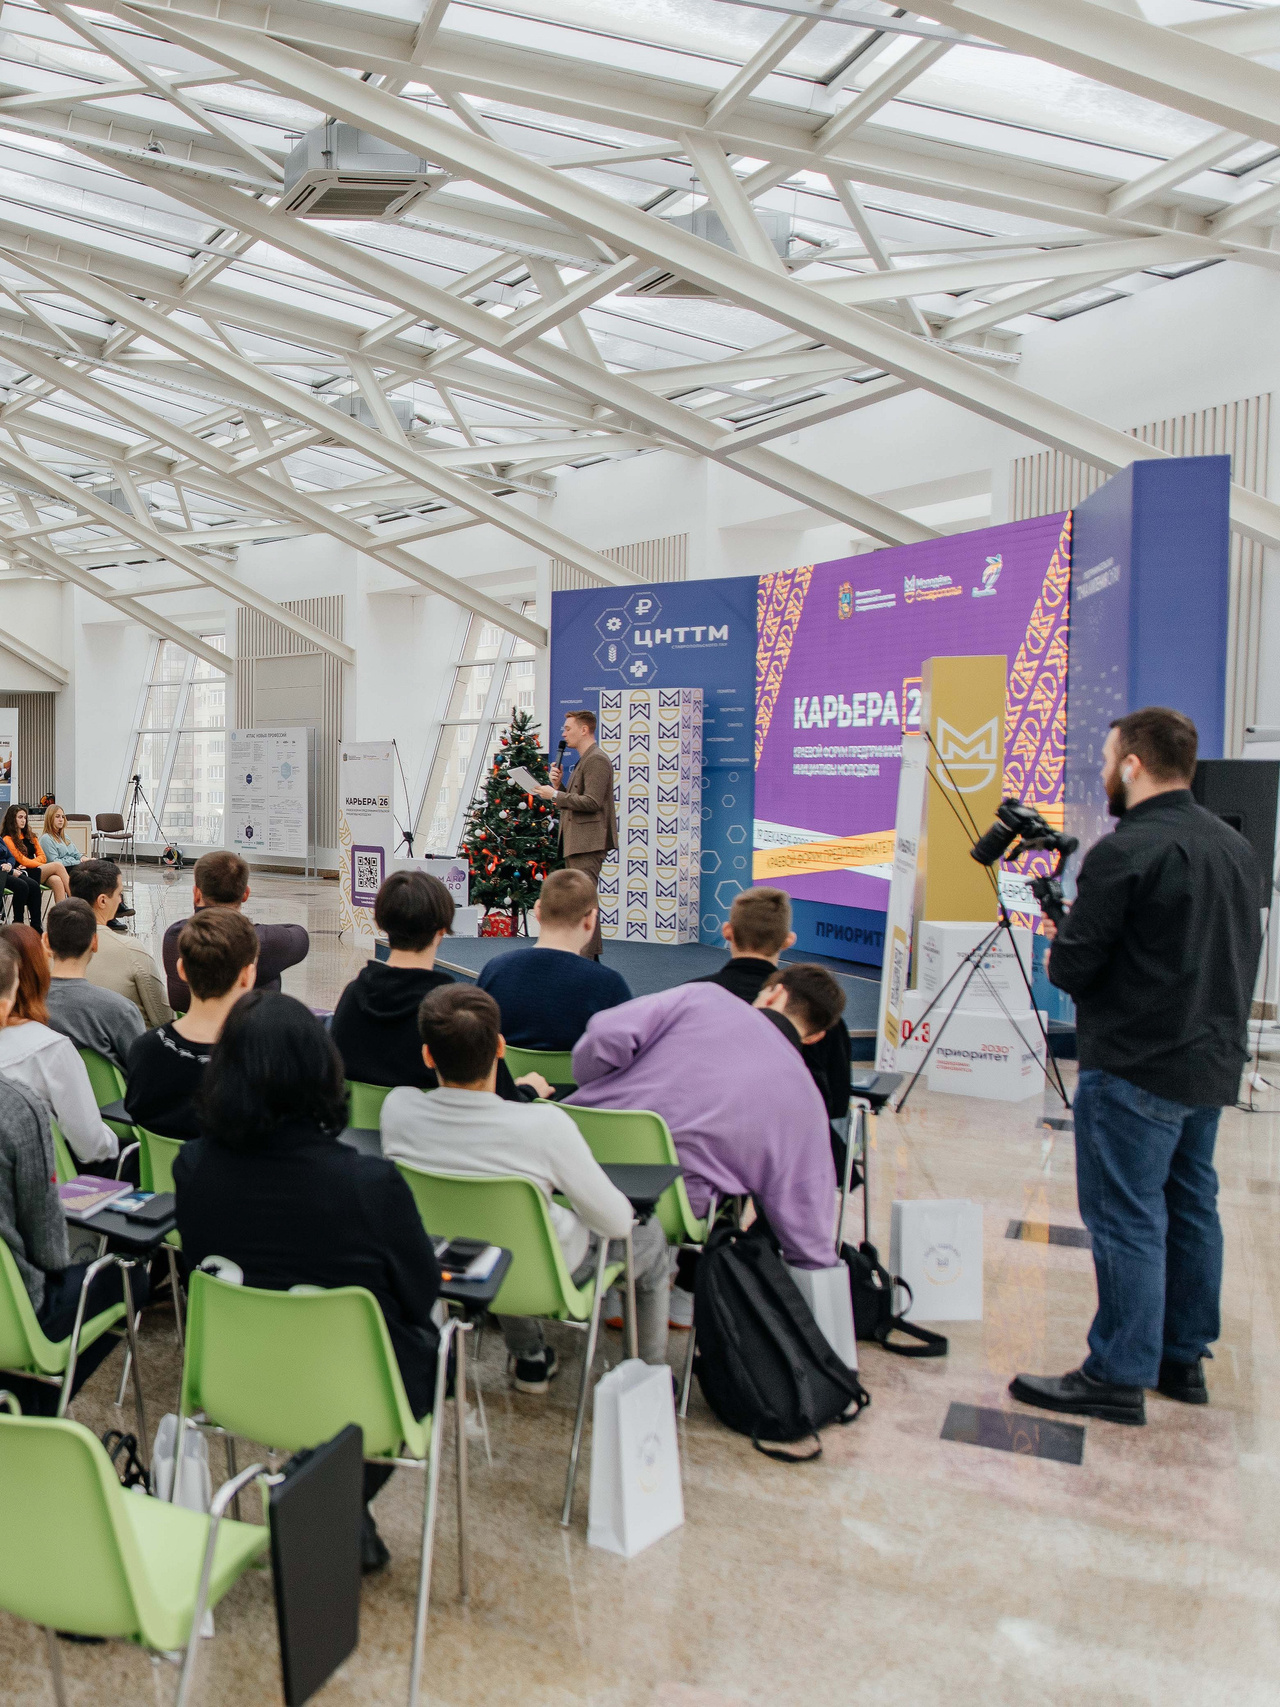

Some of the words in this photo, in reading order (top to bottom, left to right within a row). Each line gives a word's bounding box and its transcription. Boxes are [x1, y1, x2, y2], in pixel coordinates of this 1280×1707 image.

[634, 624, 729, 648] ЦНТТМ
[793, 690, 900, 729] КАРЬЕРА
[907, 688, 922, 726] 2
[346, 798, 377, 806] КАРЬЕРА
[380, 798, 389, 806] 26
[815, 921, 885, 948] ПРИОРИТ
[936, 1046, 1009, 1063] приоритет
